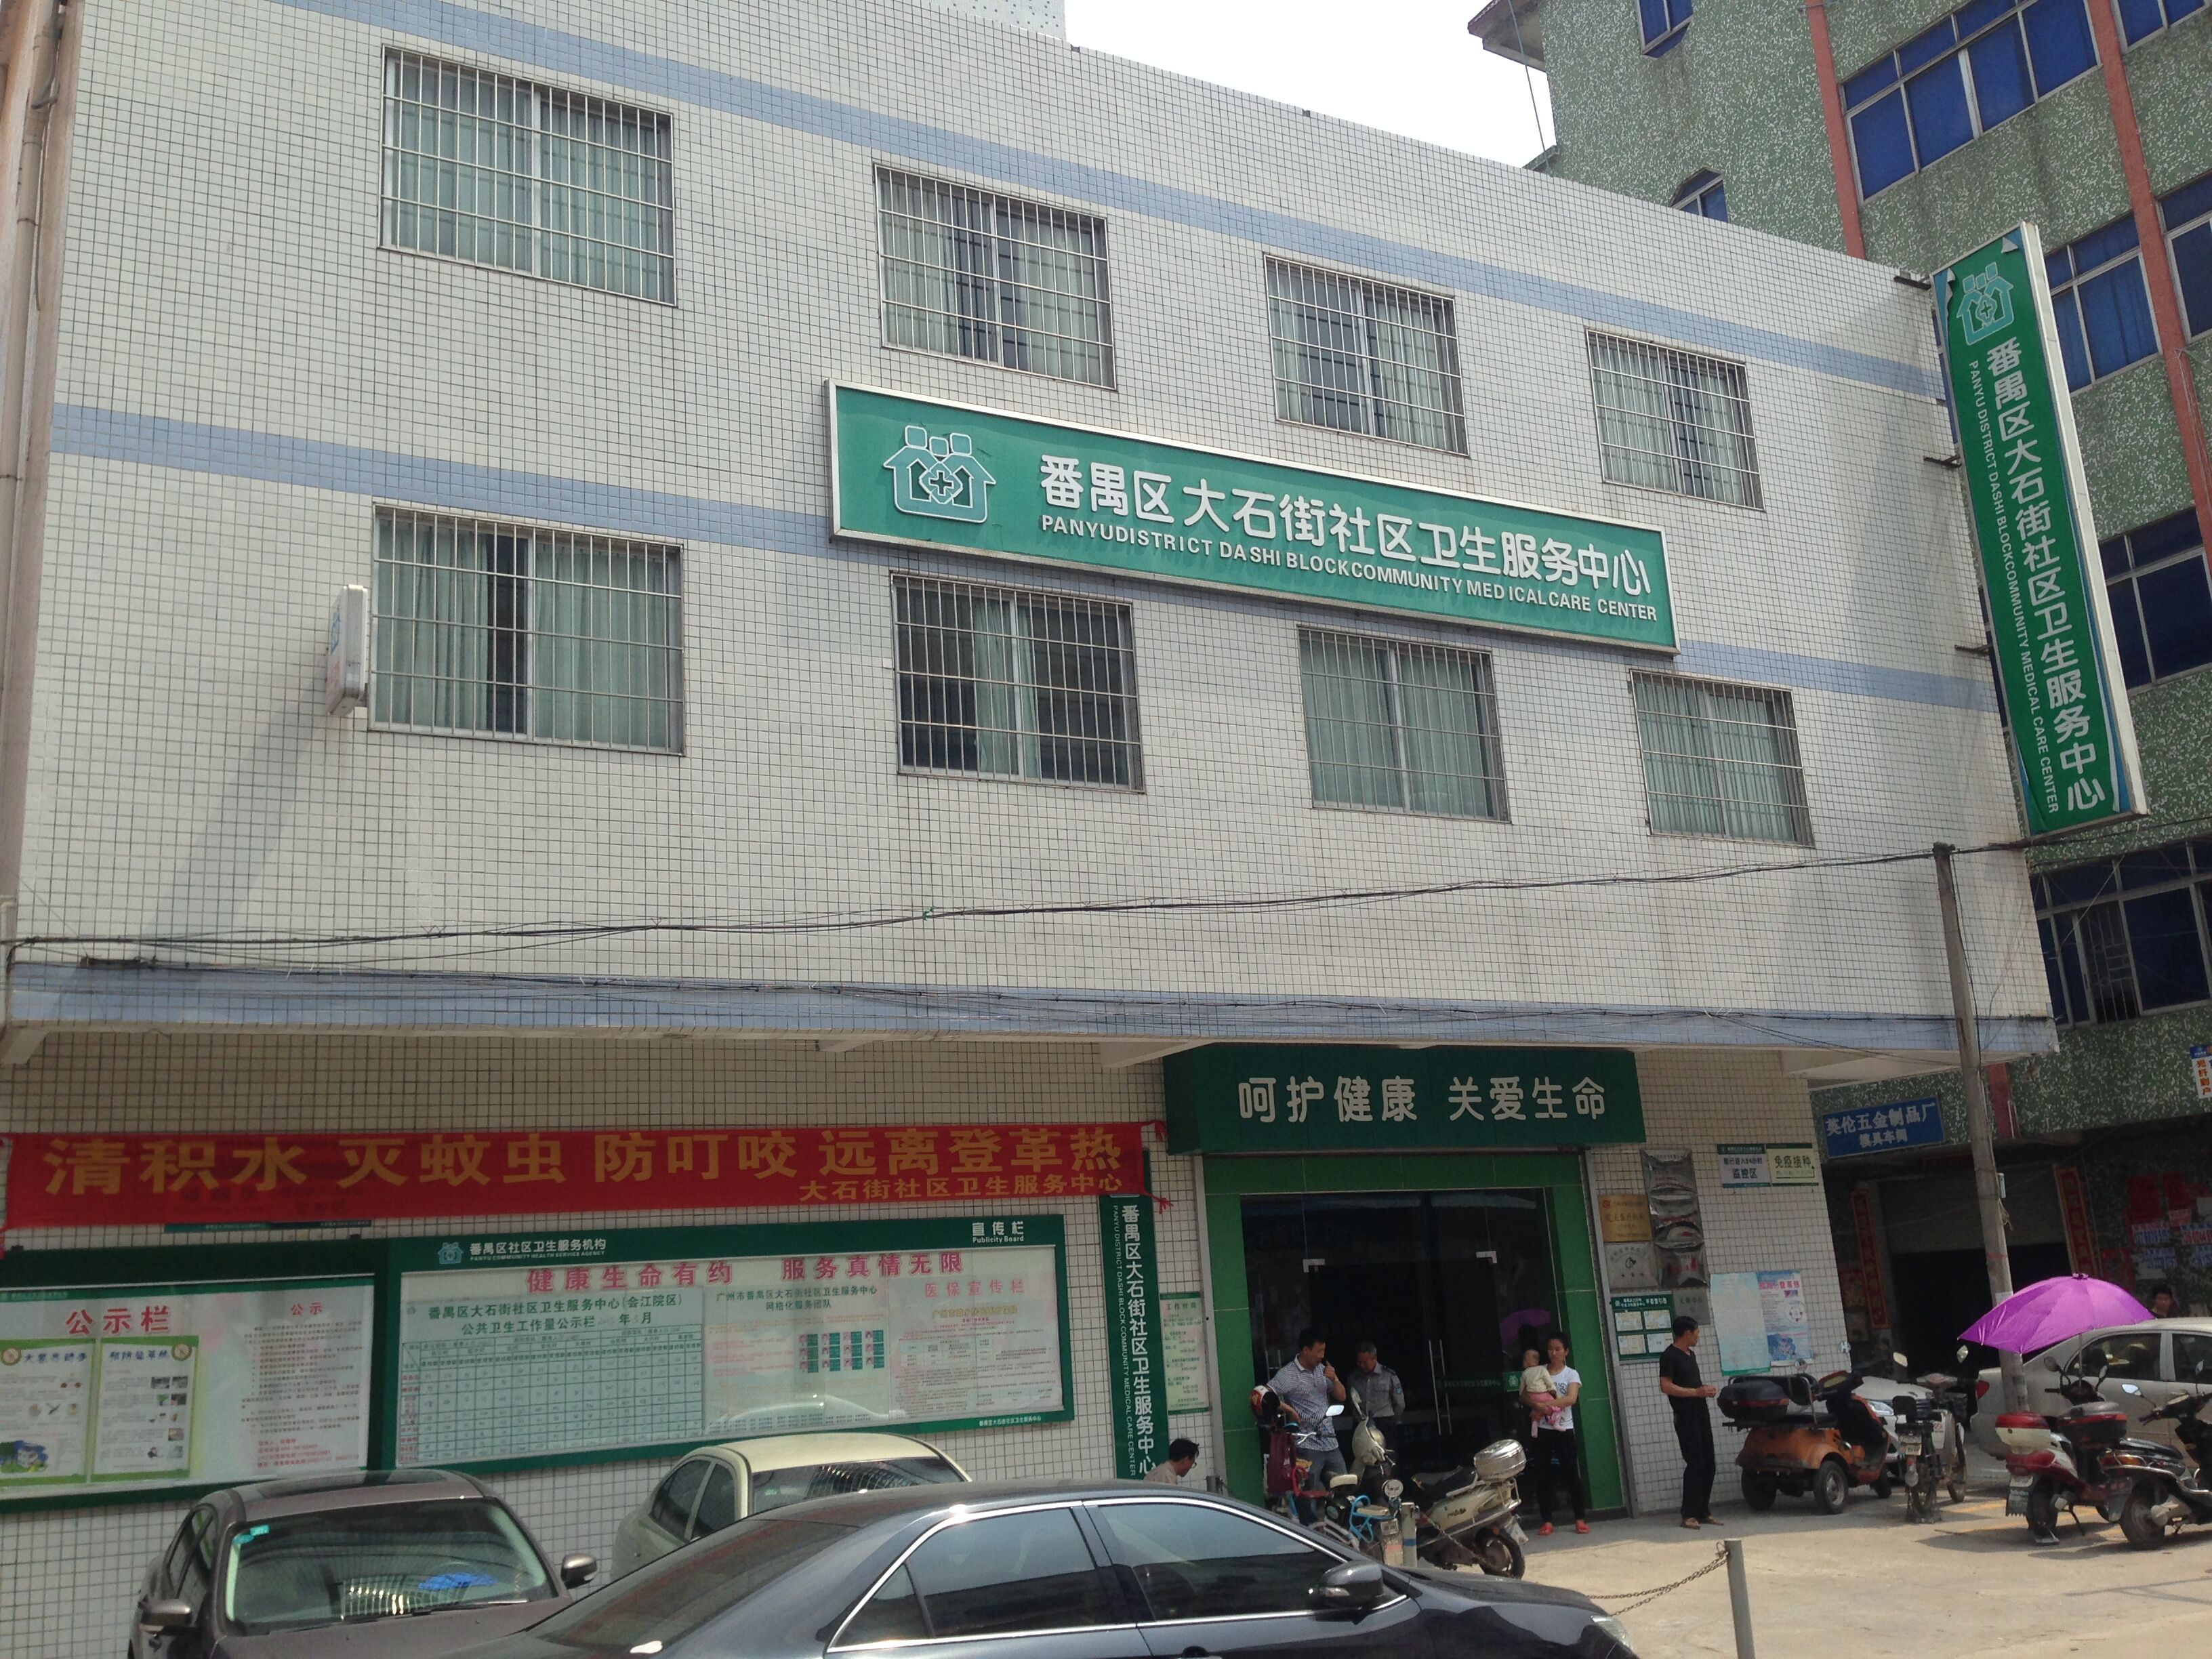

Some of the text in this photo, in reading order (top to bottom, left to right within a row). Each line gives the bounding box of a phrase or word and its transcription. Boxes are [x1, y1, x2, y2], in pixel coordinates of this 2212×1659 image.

[1969, 360, 1986, 411] PANYU
[1977, 407, 1997, 472] DISTRICT
[1990, 471, 2005, 515] DASHI
[1040, 454, 1652, 595] 番禺区大石街社区卫生服务中心
[1219, 541, 1281, 567] DASHI
[1597, 598, 1657, 621] CENTER
[1986, 336, 2106, 811] 番禺区大石街社区卫生服务中心
[2020, 651, 2041, 715] MEDICAL
[2032, 716, 2047, 756] CARE
[2039, 756, 2060, 814] CENTER
[1239, 1076, 1606, 1124] 呵护健康 关爱生命
[42, 1128, 1122, 1195] 清积水 灭蚊虫 防叮咬 远离登革热
[798, 1172, 1123, 1203] 大石街社区卫生服务中心
[972, 1221, 1025, 1237] 宣传栏
[1112, 1205, 1120, 1233] PANYU
[470, 1238, 607, 1256] 番禺区社区卫生服务机构
[972, 1235, 1025, 1244] Publicity Board
[525, 1250, 964, 1294] 健康生命有约 服务真情无限
[924, 1278, 1025, 1298] 医保宣传栏
[1116, 1271, 1124, 1296] DASHI
[66, 1305, 169, 1336] 公示栏
[291, 1302, 325, 1317] 公示
[1122, 1204, 1156, 1474] 番禺区大石街社区卫生服务中心
[1124, 1378, 1132, 1414] MEDICAL
[1126, 1416, 1134, 1439] CARE
[1128, 1440, 1136, 1476] CENTER
